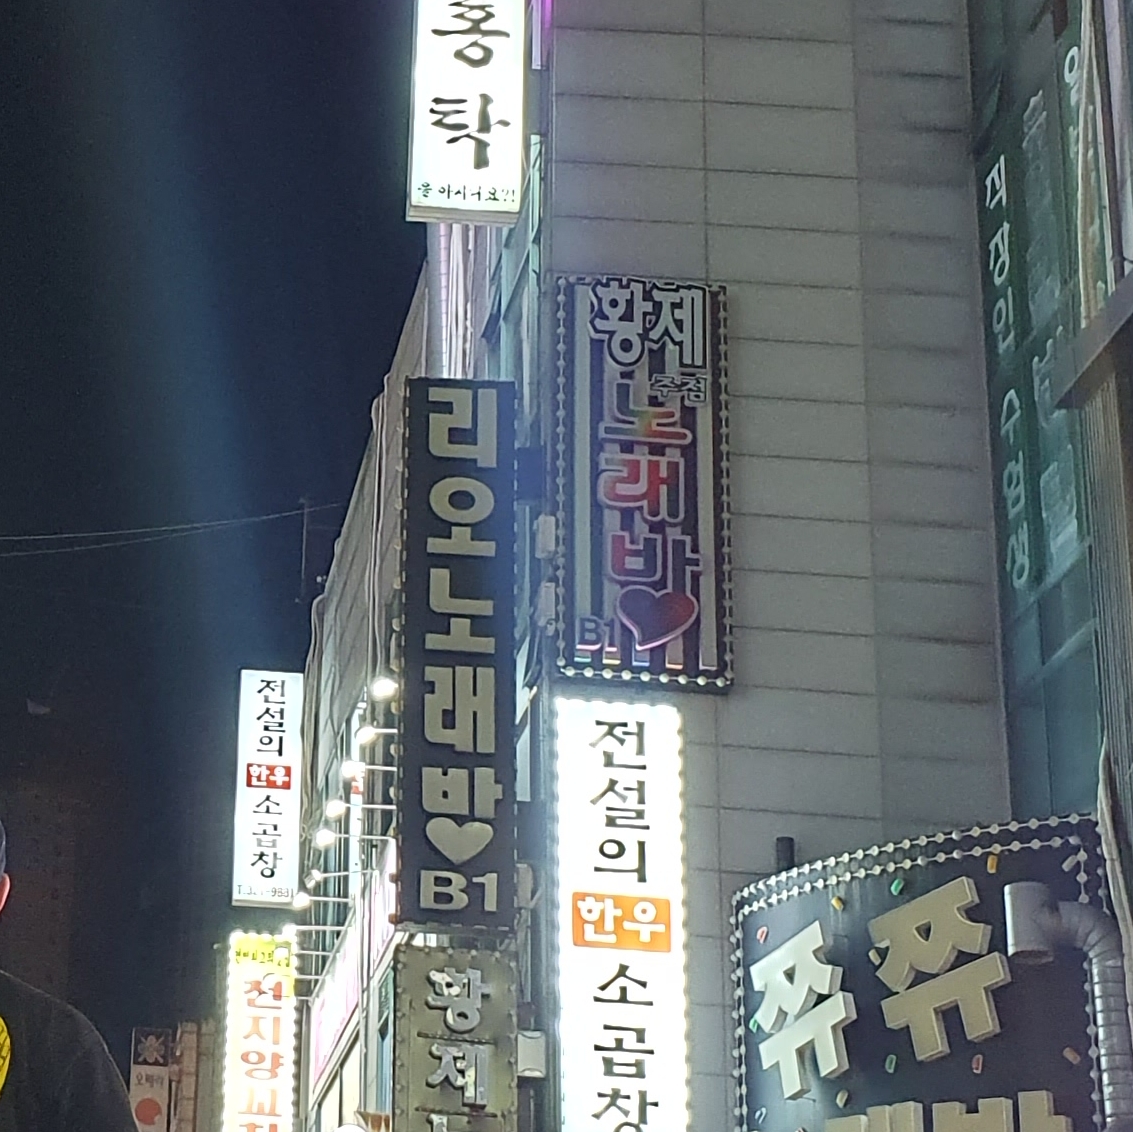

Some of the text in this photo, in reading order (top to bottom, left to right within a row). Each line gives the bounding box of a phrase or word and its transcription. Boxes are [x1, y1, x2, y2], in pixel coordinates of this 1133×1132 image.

[589, 282, 708, 368] 황제
[248, 764, 291, 788] 한우
[589, 719, 651, 884] 전설의
[419, 871, 497, 912] B1
[576, 896, 667, 946] 한우
